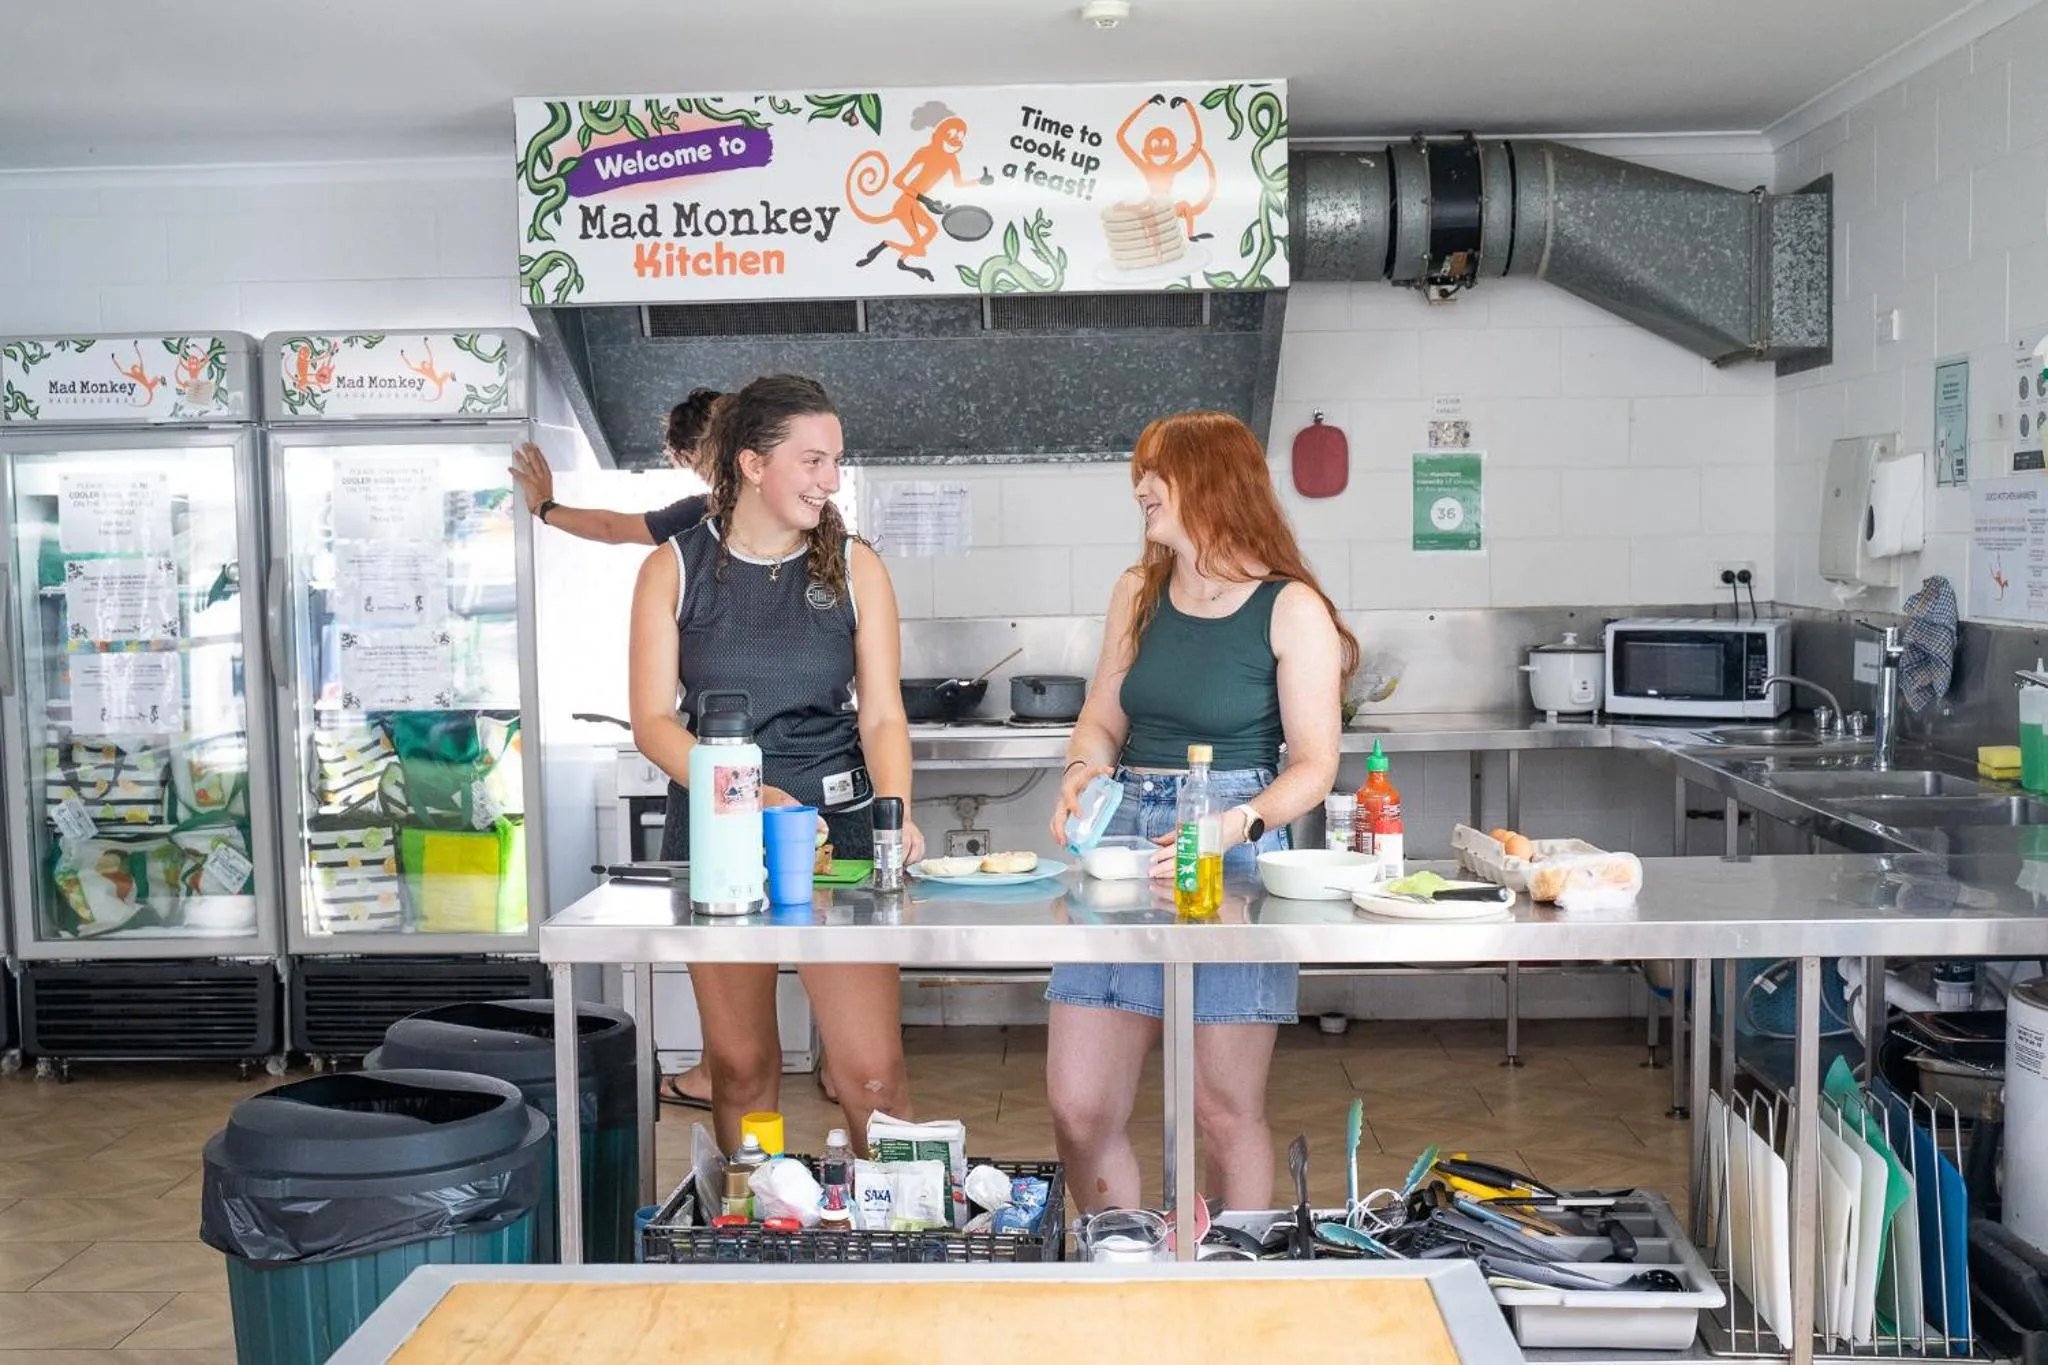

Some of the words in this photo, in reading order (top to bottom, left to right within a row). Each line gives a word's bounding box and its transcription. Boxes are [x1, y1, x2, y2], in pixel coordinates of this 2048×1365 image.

[1020, 105, 1073, 139] Time
[1080, 124, 1103, 147] to
[594, 143, 712, 181] Welcome
[719, 136, 746, 157] to
[1009, 134, 1067, 163] cook
[1071, 150, 1101, 175] up
[1002, 161, 1018, 178] a
[1024, 161, 1097, 201] feast!
[578, 203, 662, 240] Mad
[673, 200, 840, 242] Monkey
[634, 241, 785, 278] Kitchen
[49, 380, 77, 394] Mad
[80, 380, 137, 395] Monkey
[336, 376, 364, 389] Mad
[369, 375, 425, 391] Monkey
[1437, 507, 1456, 520] 36
[864, 1189, 892, 1203] SAXA
